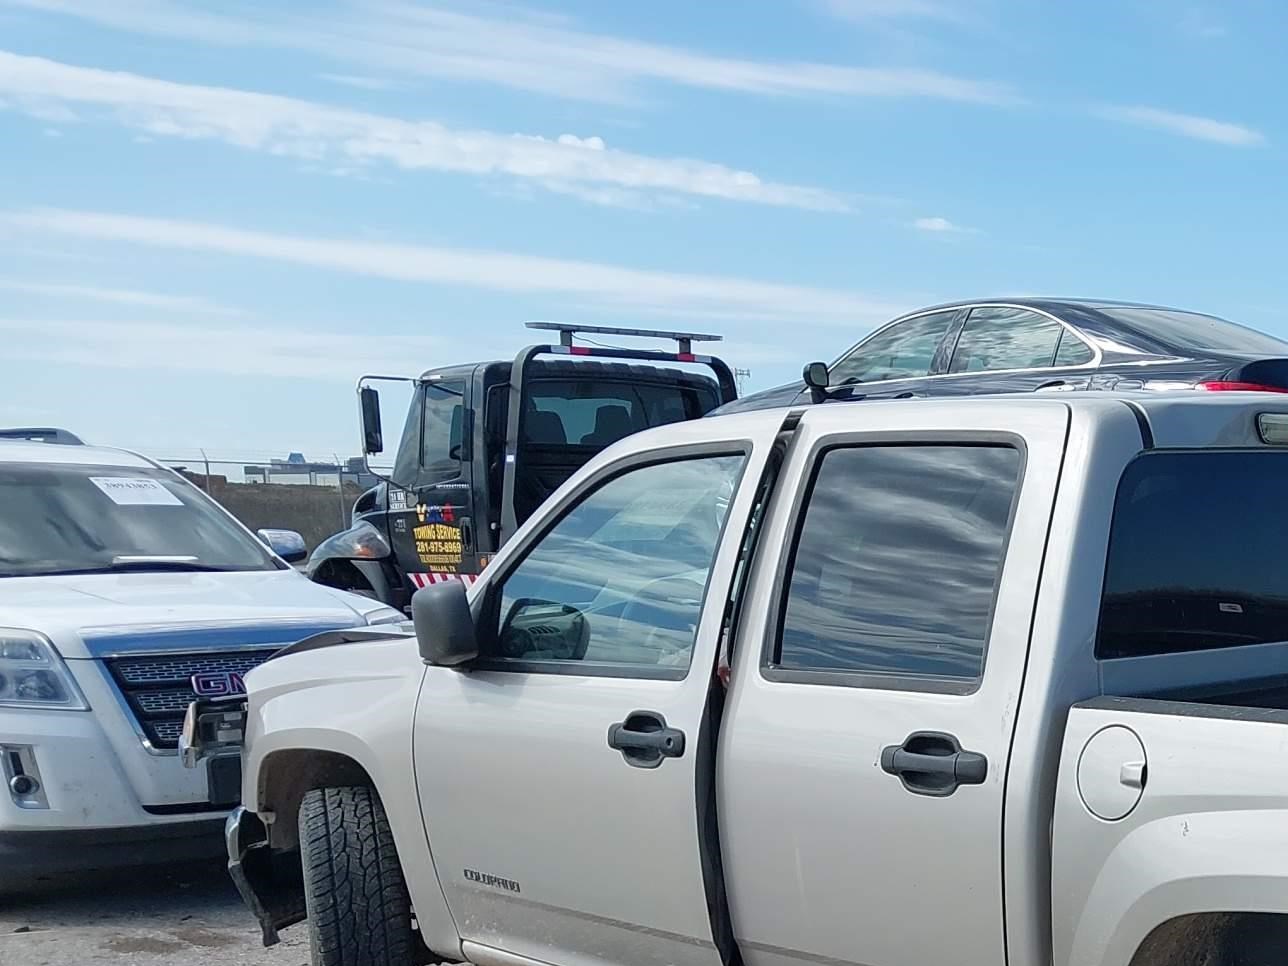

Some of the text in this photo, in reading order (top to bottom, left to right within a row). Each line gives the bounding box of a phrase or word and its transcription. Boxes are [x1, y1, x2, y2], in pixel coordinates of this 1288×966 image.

[413, 524, 436, 540] TOWING
[436, 524, 461, 540] SERVICE
[191, 672, 247, 696] GM
